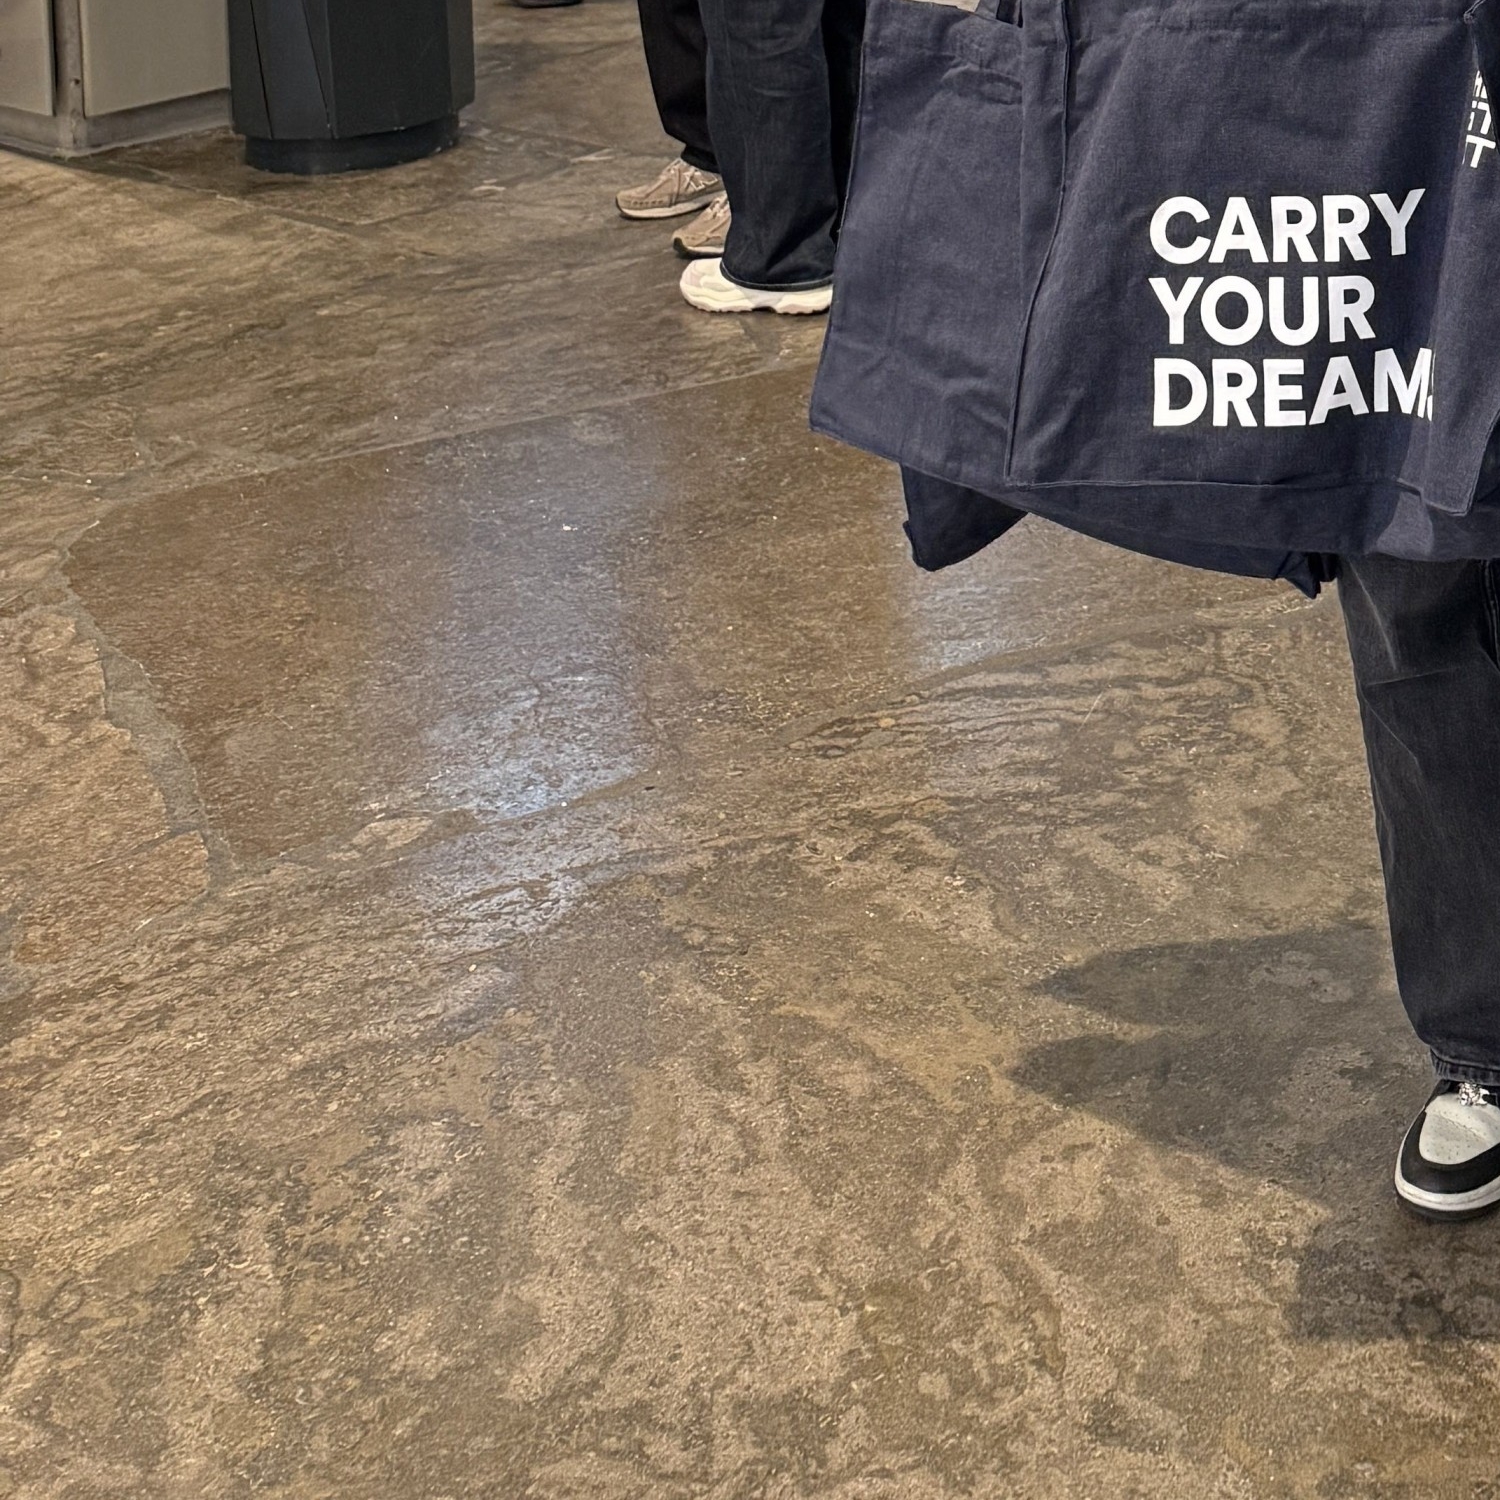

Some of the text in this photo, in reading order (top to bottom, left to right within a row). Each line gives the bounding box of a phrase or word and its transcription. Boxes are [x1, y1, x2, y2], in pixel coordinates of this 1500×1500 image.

[1150, 188, 1426, 264] CARRY
[1148, 275, 1376, 346] YOUR
[1153, 347, 1436, 427] DREAM
